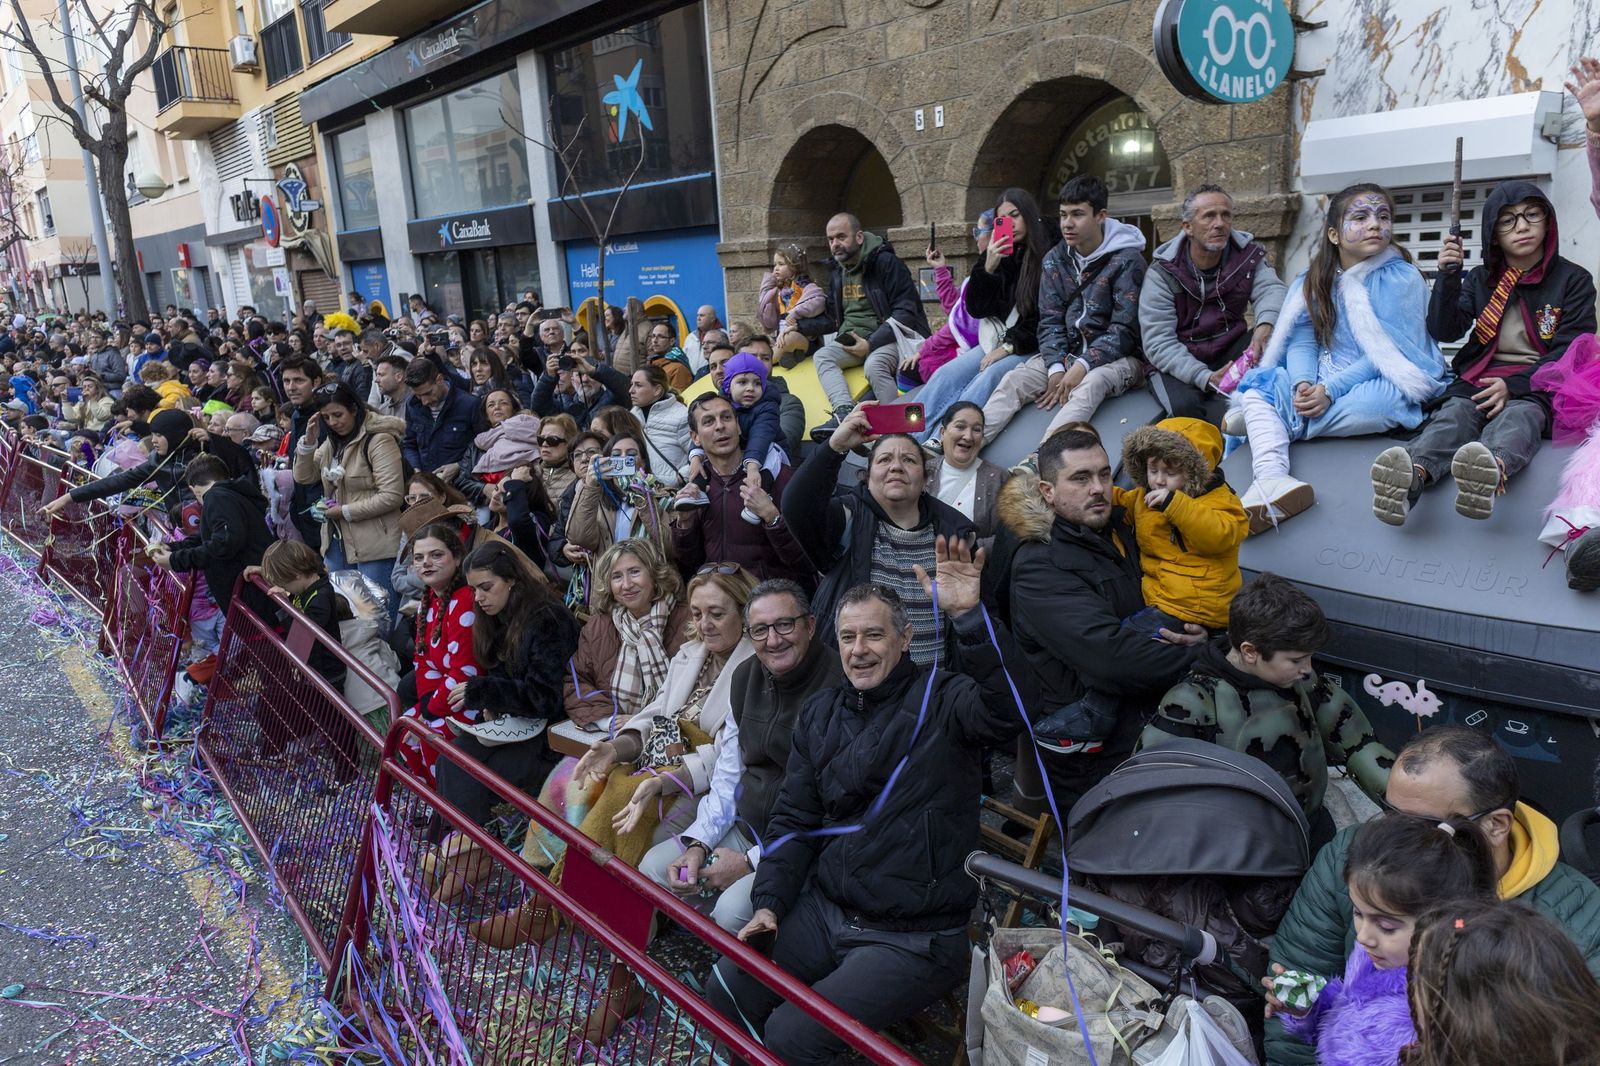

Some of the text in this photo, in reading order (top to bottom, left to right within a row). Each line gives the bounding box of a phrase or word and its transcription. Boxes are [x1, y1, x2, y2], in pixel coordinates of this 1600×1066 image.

[1199, 55, 1277, 98] LLANELO
[1105, 165, 1161, 193] 5 y 7
[452, 218, 491, 239] CaixaBank
